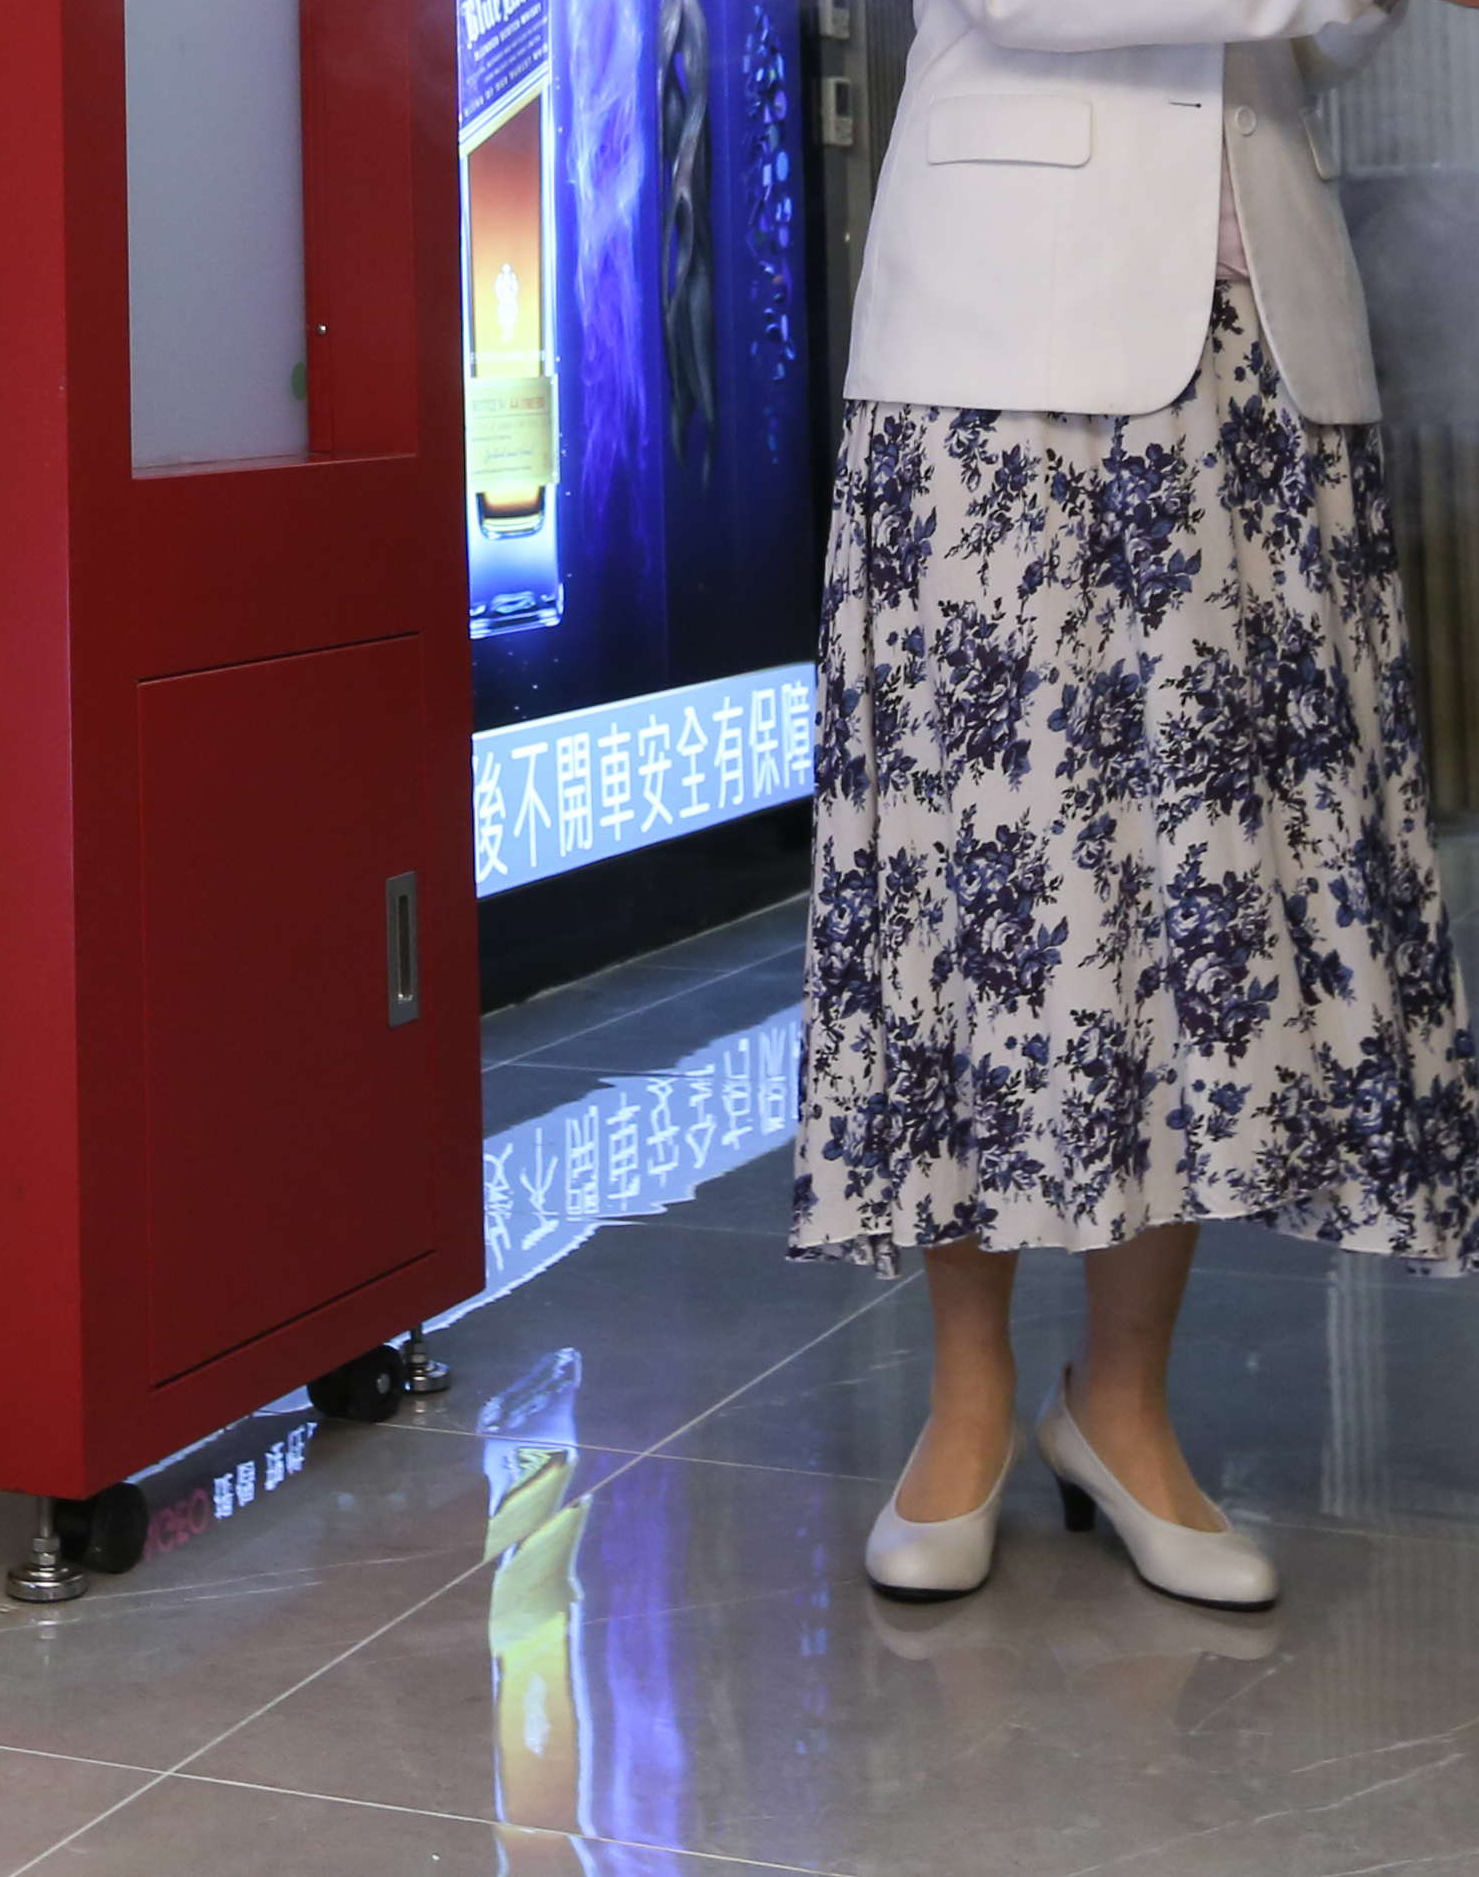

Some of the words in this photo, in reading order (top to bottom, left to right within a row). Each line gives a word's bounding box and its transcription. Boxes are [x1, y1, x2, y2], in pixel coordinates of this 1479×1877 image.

[472, 679, 811, 885] 後不開車安全有保障
